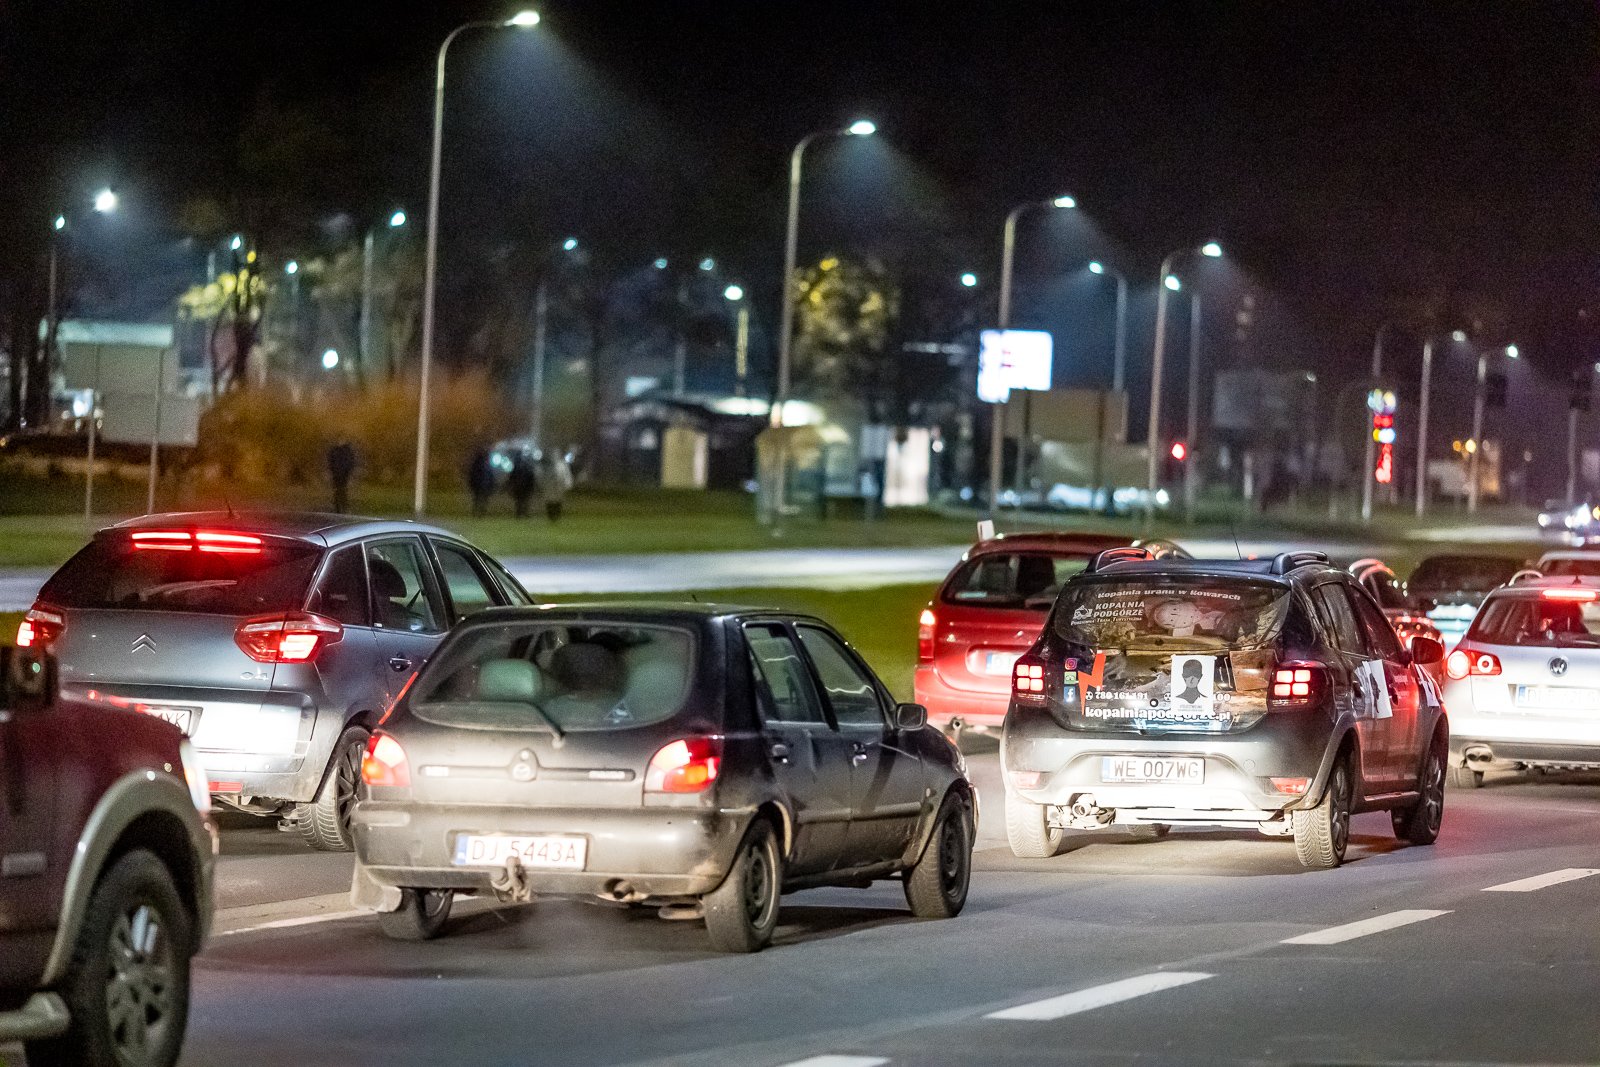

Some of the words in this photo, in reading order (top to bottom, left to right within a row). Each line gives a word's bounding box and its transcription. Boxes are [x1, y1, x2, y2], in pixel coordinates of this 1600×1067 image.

[1097, 589, 1141, 599] Kopalnia
[1189, 589, 1241, 601] Kowarach
[1095, 601, 1145, 610] KOPALNIA
[1093, 609, 1144, 618] PODGÓRZE
[1114, 760, 1136, 777] WE
[1143, 760, 1199, 778] 007WG
[472, 840, 498, 860] DJ
[510, 840, 576, 862] 5443A
